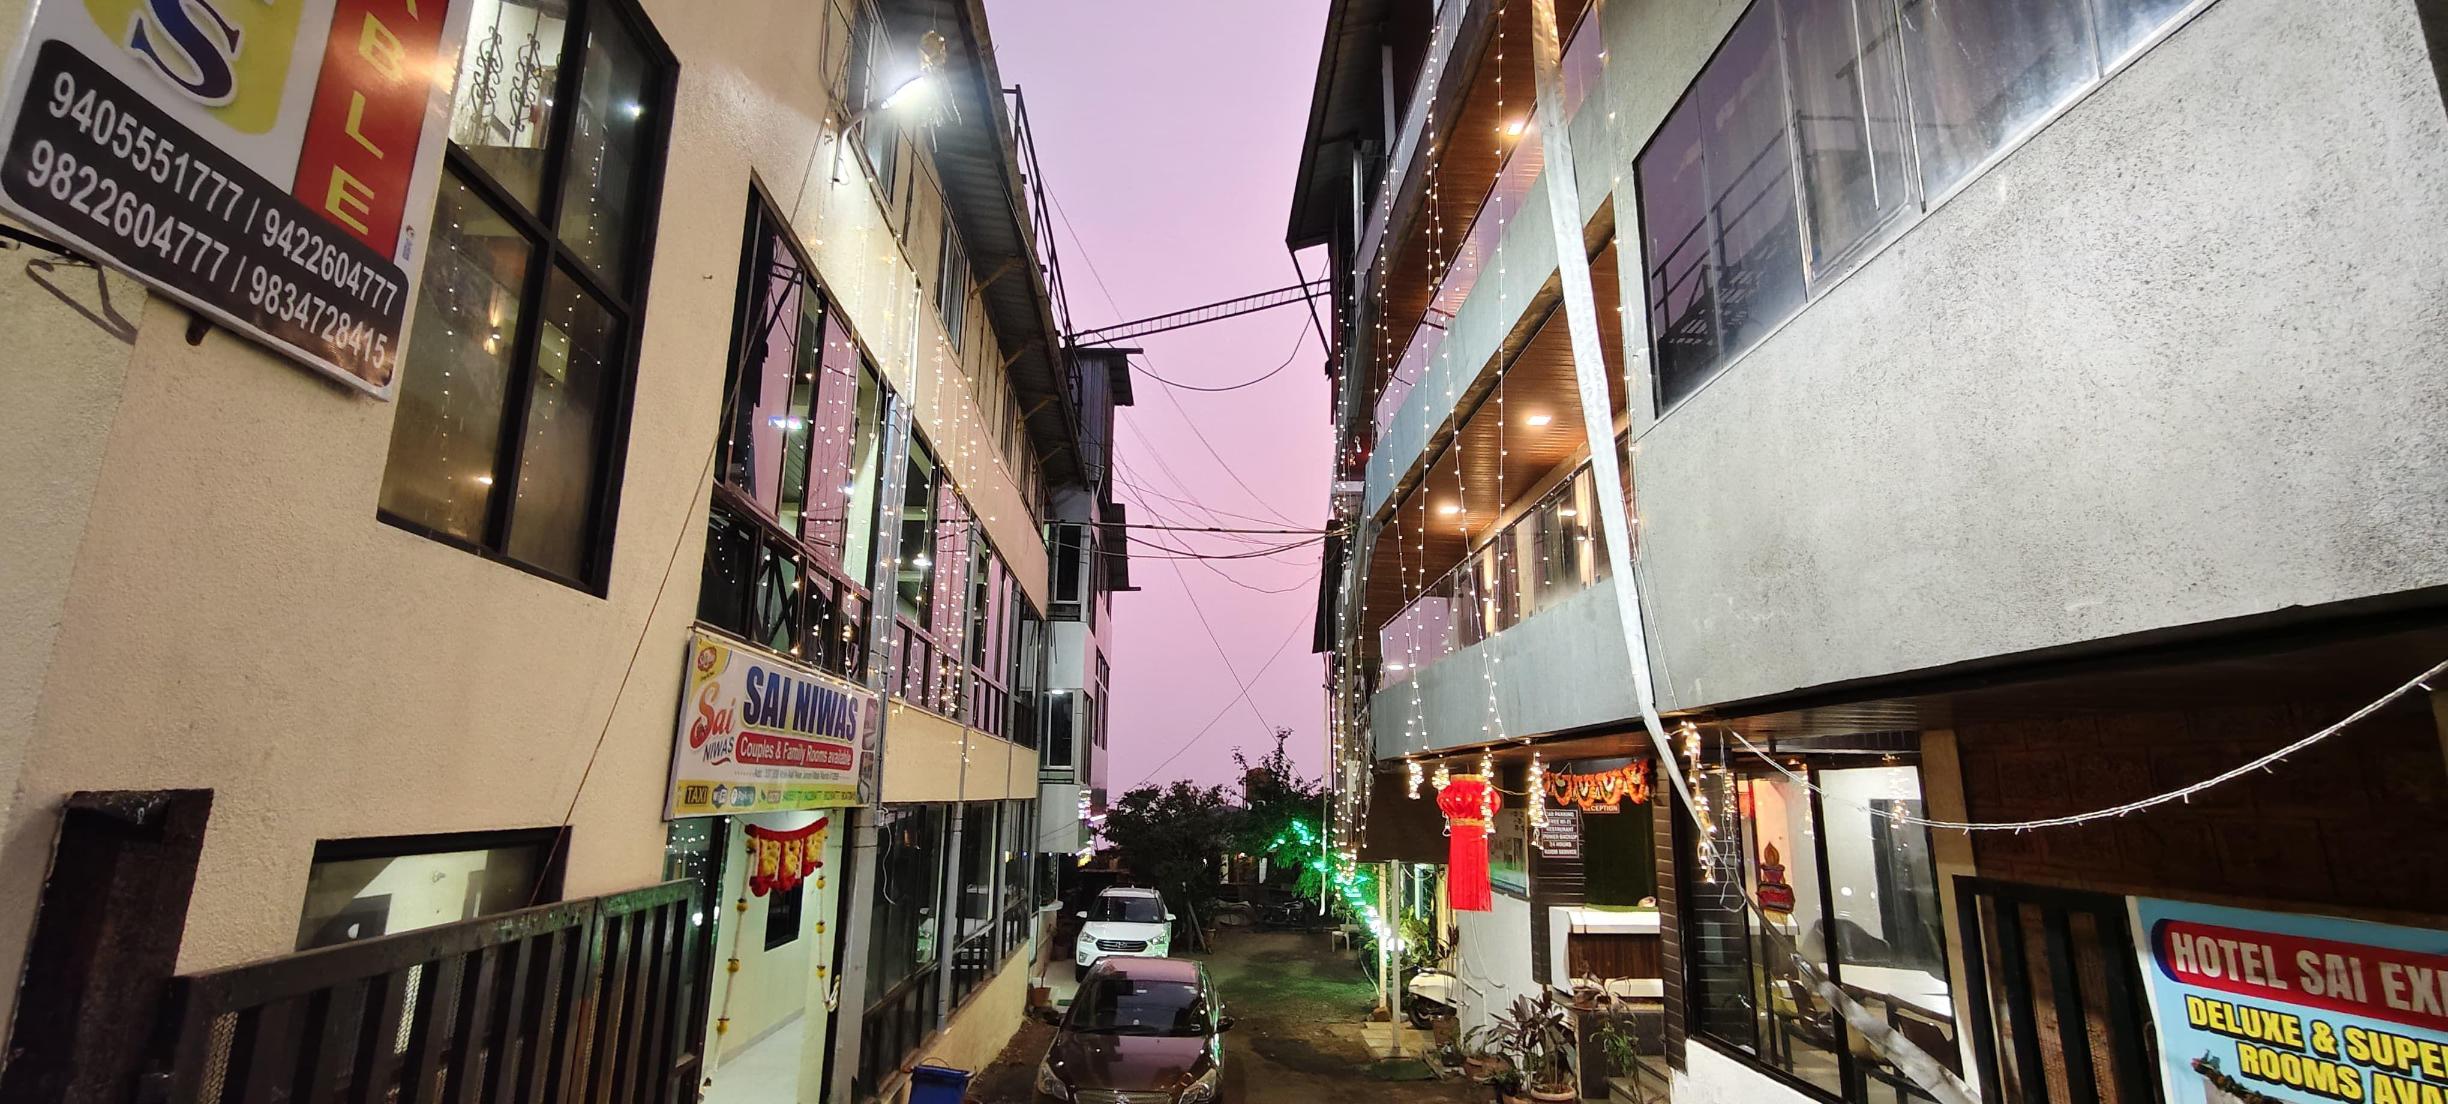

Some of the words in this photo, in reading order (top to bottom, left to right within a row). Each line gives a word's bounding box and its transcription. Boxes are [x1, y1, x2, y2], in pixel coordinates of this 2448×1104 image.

[48, 71, 244, 222] 9405551777
[262, 207, 398, 317] 9422604777
[28, 139, 229, 283] 9822604777
[248, 265, 387, 370] 9834728415
[690, 682, 736, 749] Sai
[744, 666, 791, 728] SAI
[793, 682, 858, 742] NIWAS
[703, 736, 735, 762] NIWAS
[740, 736, 775, 763] Couples
[775, 740, 782, 760] &
[783, 742, 806, 766] Family
[806, 744, 828, 763] Rooms
[687, 786, 708, 804] TAXI
[2171, 931, 2288, 990] HOTEL
[2296, 949, 2368, 1004] SAI
[2186, 994, 2304, 1049] DELUXE
[2311, 1020, 2339, 1058] &
[2343, 1025, 2448, 1080] SUPE
[2238, 1042, 2364, 1102] ROOMS
